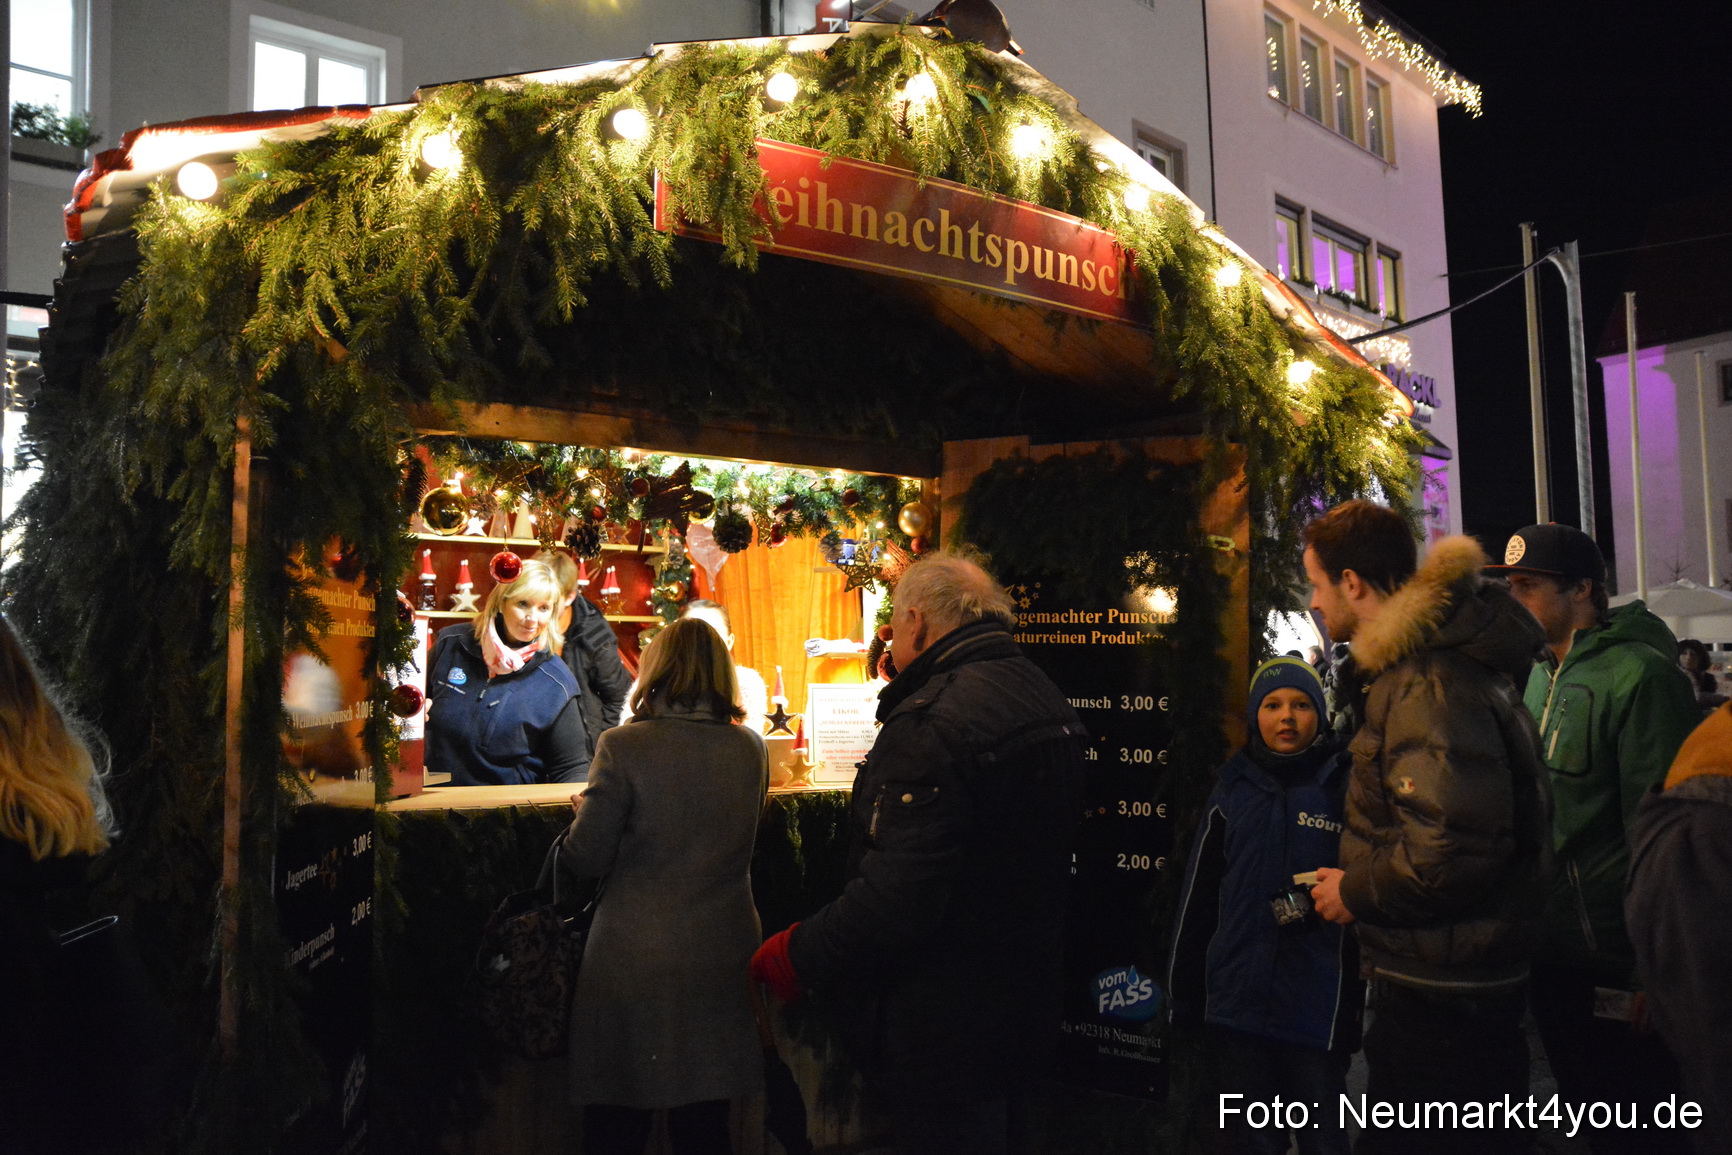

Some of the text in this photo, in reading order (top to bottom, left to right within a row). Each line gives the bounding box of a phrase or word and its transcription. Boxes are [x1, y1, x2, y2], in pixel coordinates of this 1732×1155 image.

[764, 176, 1127, 299] eihnachtspunsc
[1013, 631, 1086, 645] aturreinen
[1120, 695, 1154, 713] 3,00
[1158, 696, 1169, 712] €
[1119, 747, 1168, 765] 3,00 €
[1118, 800, 1167, 818] 3,00 €
[1116, 853, 1166, 871] 2,00 €
[286, 922, 335, 967] inderpunsch
[1098, 971, 1127, 990] vom
[1099, 979, 1153, 1014] FASS
